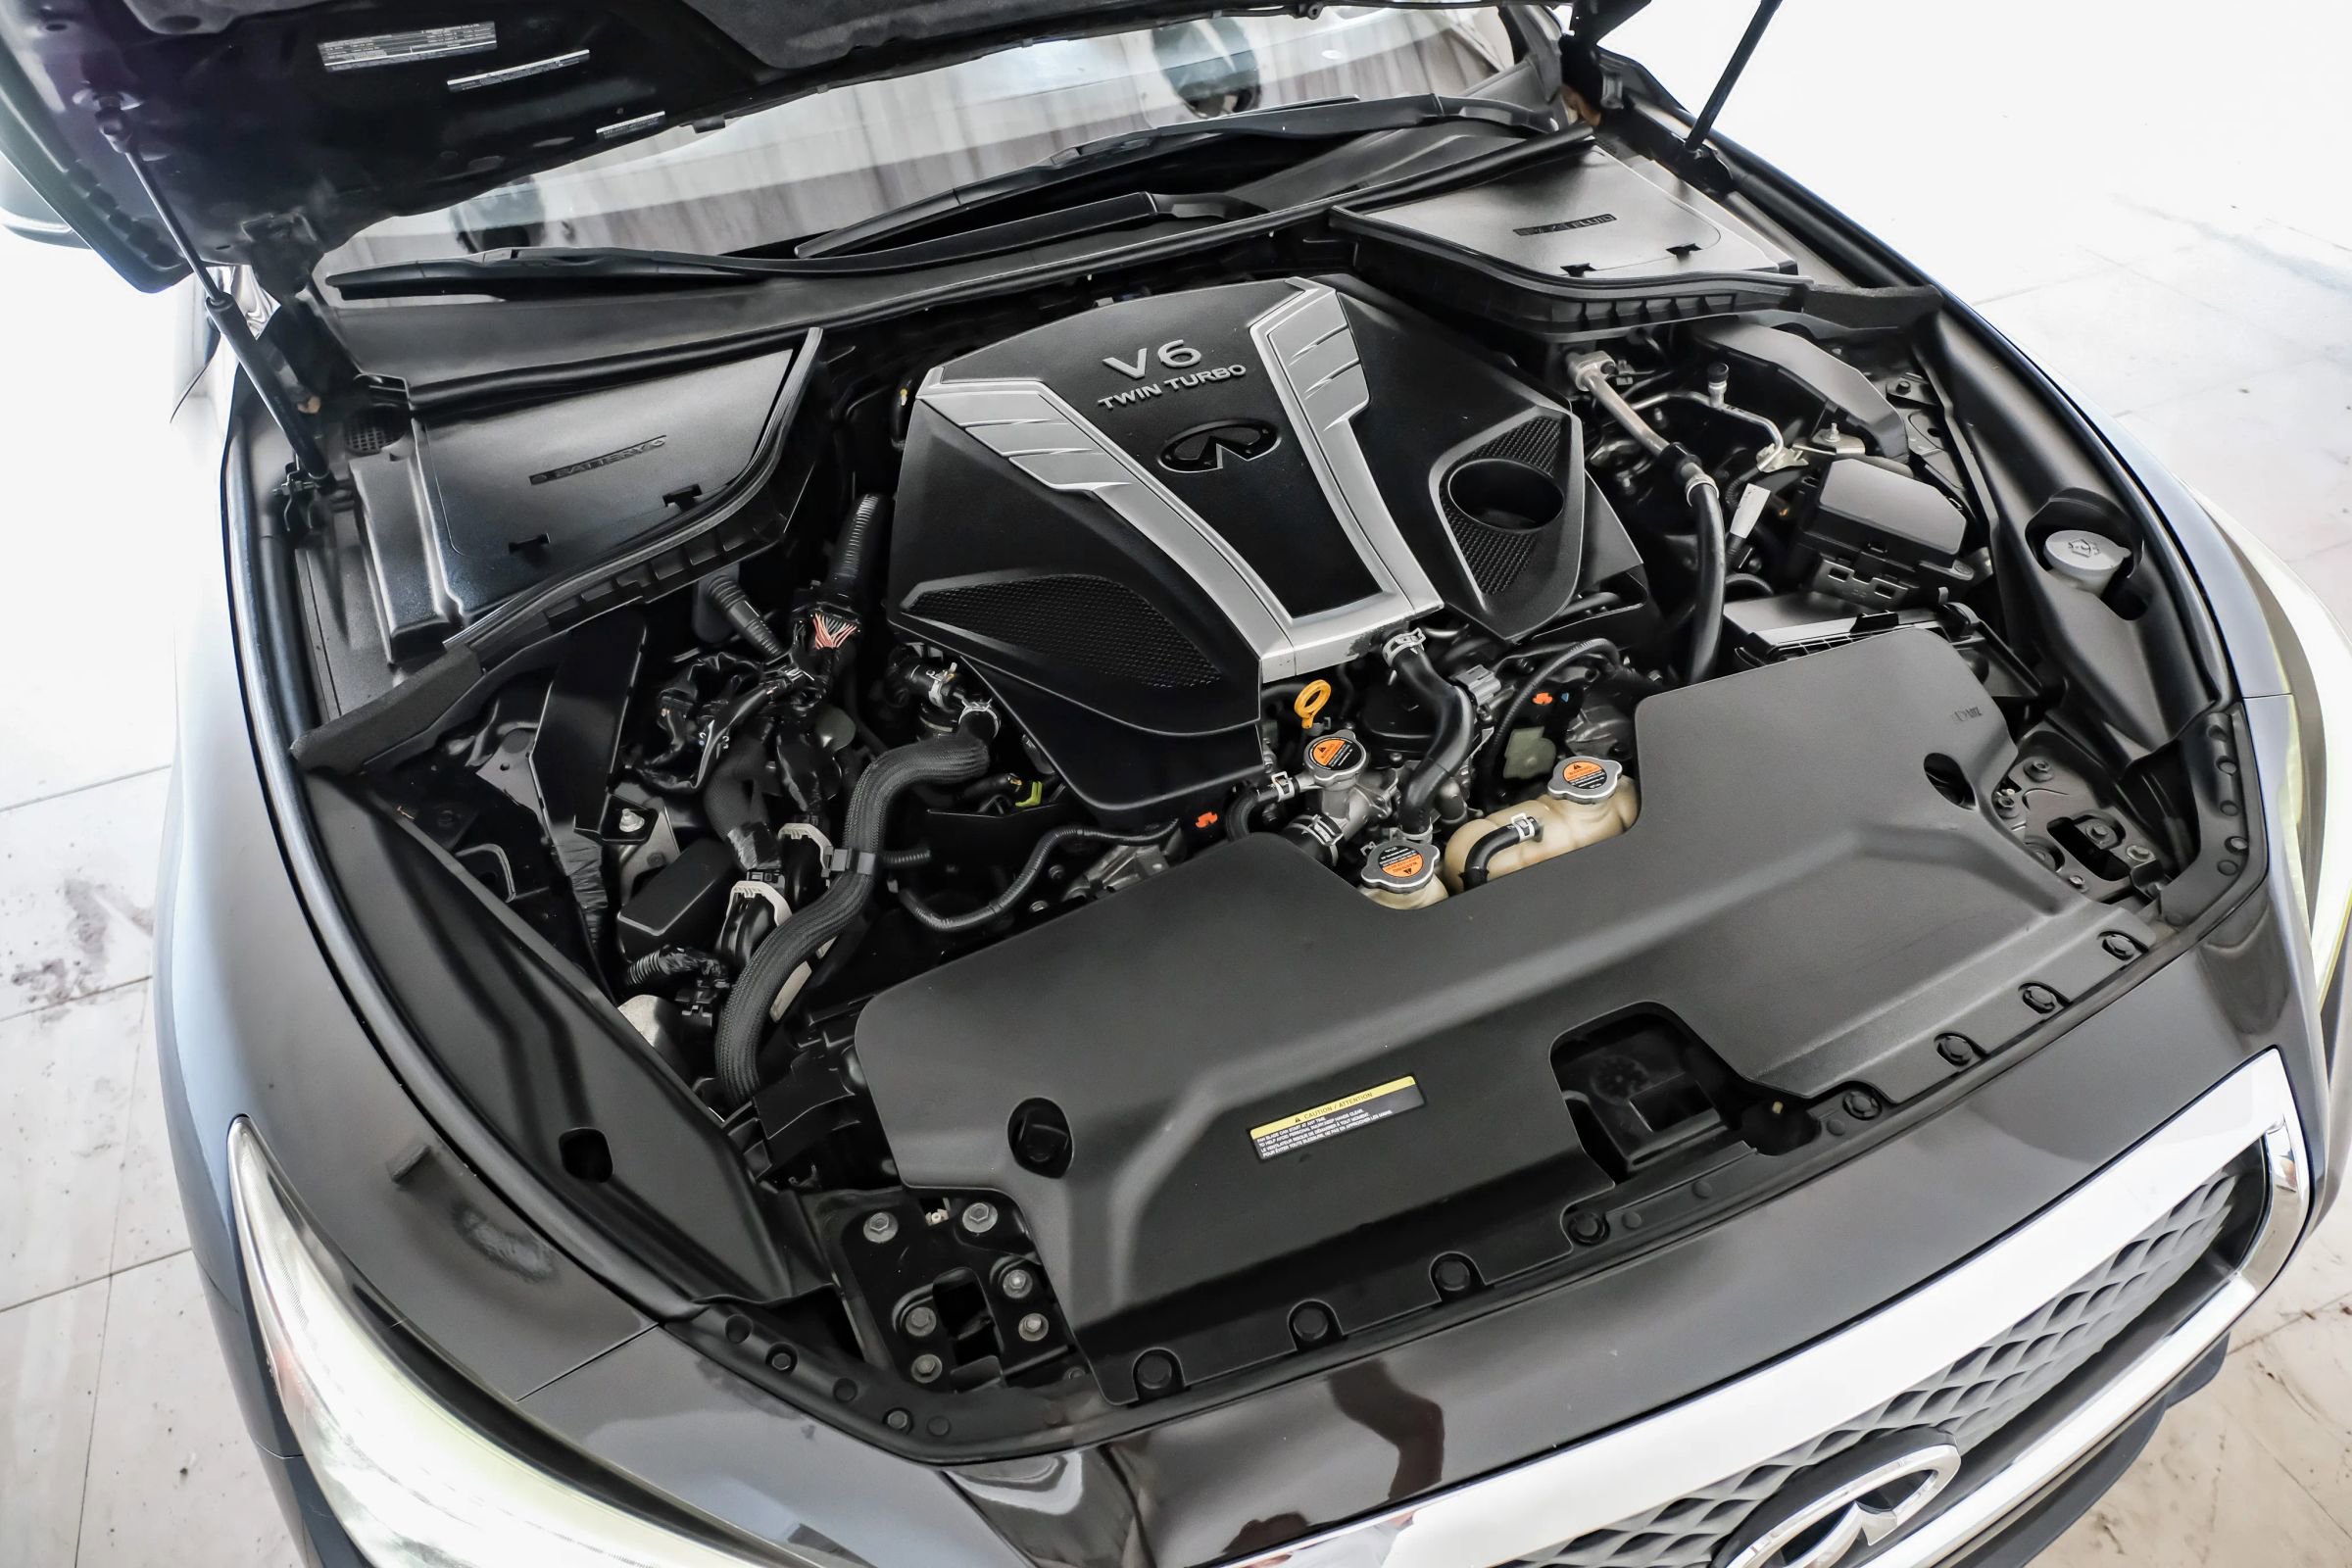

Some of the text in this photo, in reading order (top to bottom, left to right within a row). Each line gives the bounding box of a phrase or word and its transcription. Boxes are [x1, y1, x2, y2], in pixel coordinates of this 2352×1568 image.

[1102, 339, 1202, 380] V6
[1097, 365, 1248, 410] TWIN TURBO
[555, 443, 646, 478] BATTERY
[1303, 1105, 1332, 1119] CAUTION
[1338, 1093, 1372, 1107] ATTENTION
